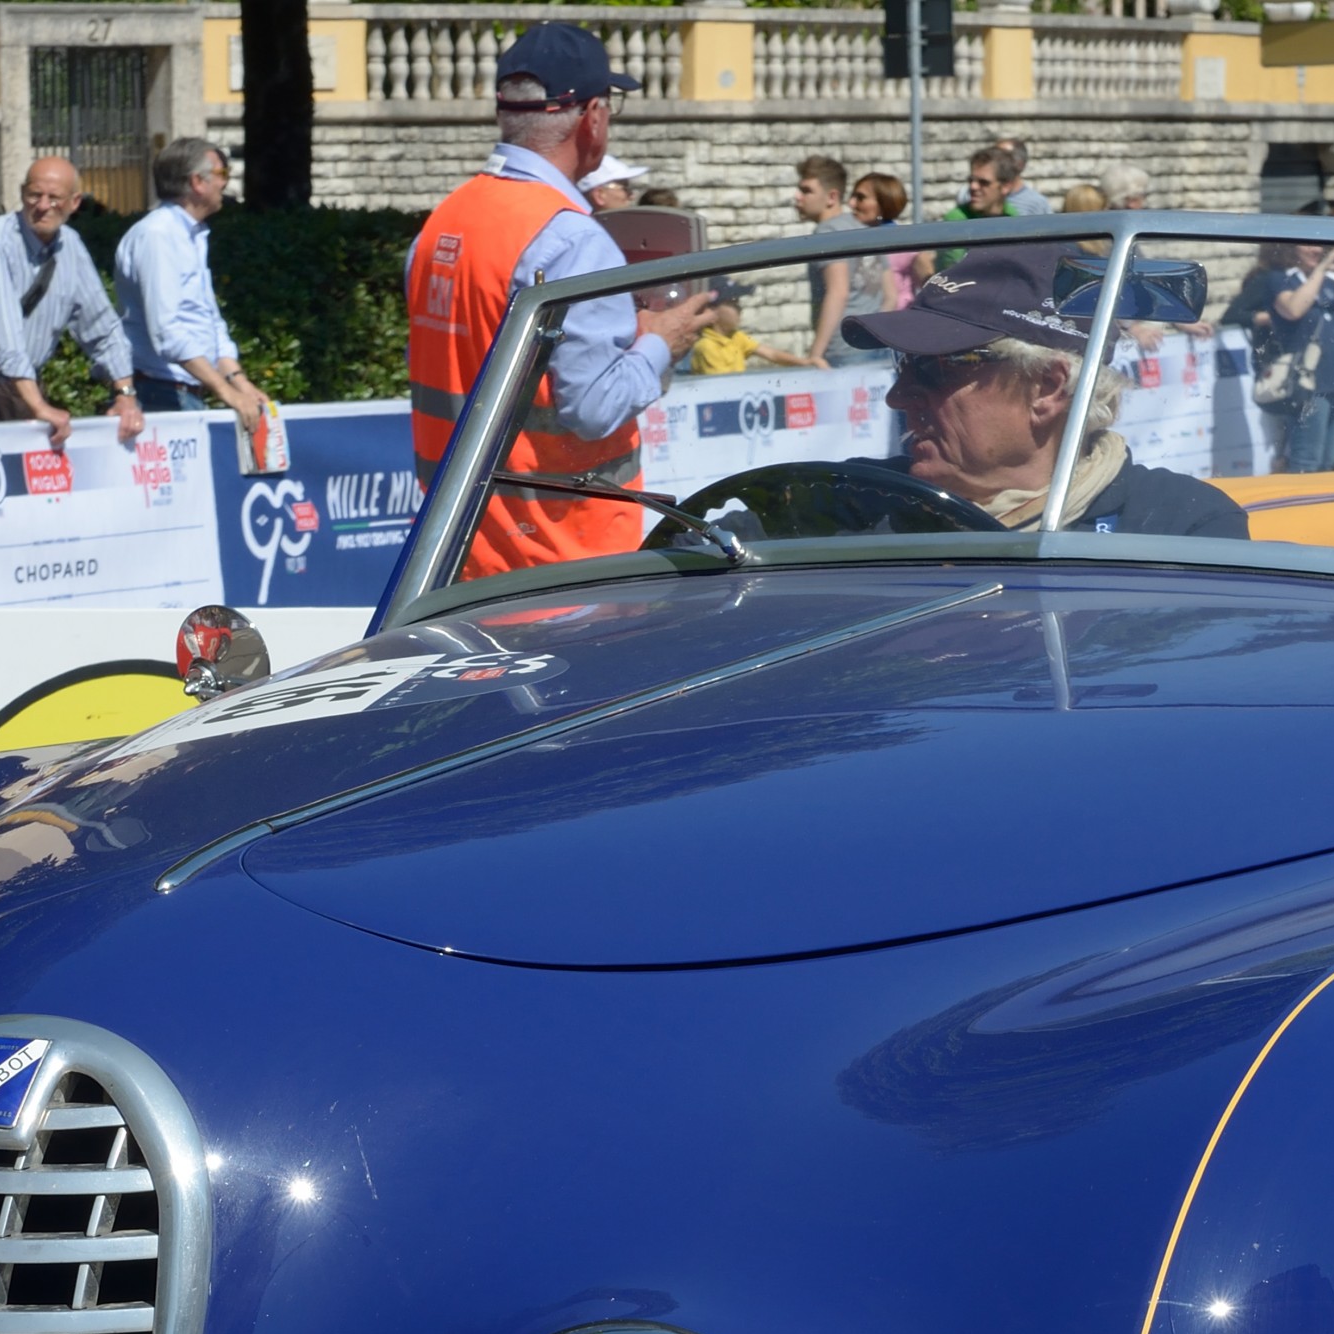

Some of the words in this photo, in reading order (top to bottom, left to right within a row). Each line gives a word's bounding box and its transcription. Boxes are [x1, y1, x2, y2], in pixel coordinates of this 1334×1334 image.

[169, 438, 197, 460] 2017
[28, 456, 61, 473] 1000
[31, 473, 69, 491] MIGLIA
[326, 472, 385, 520] MILLE
[14, 559, 99, 583] CHOPARD
